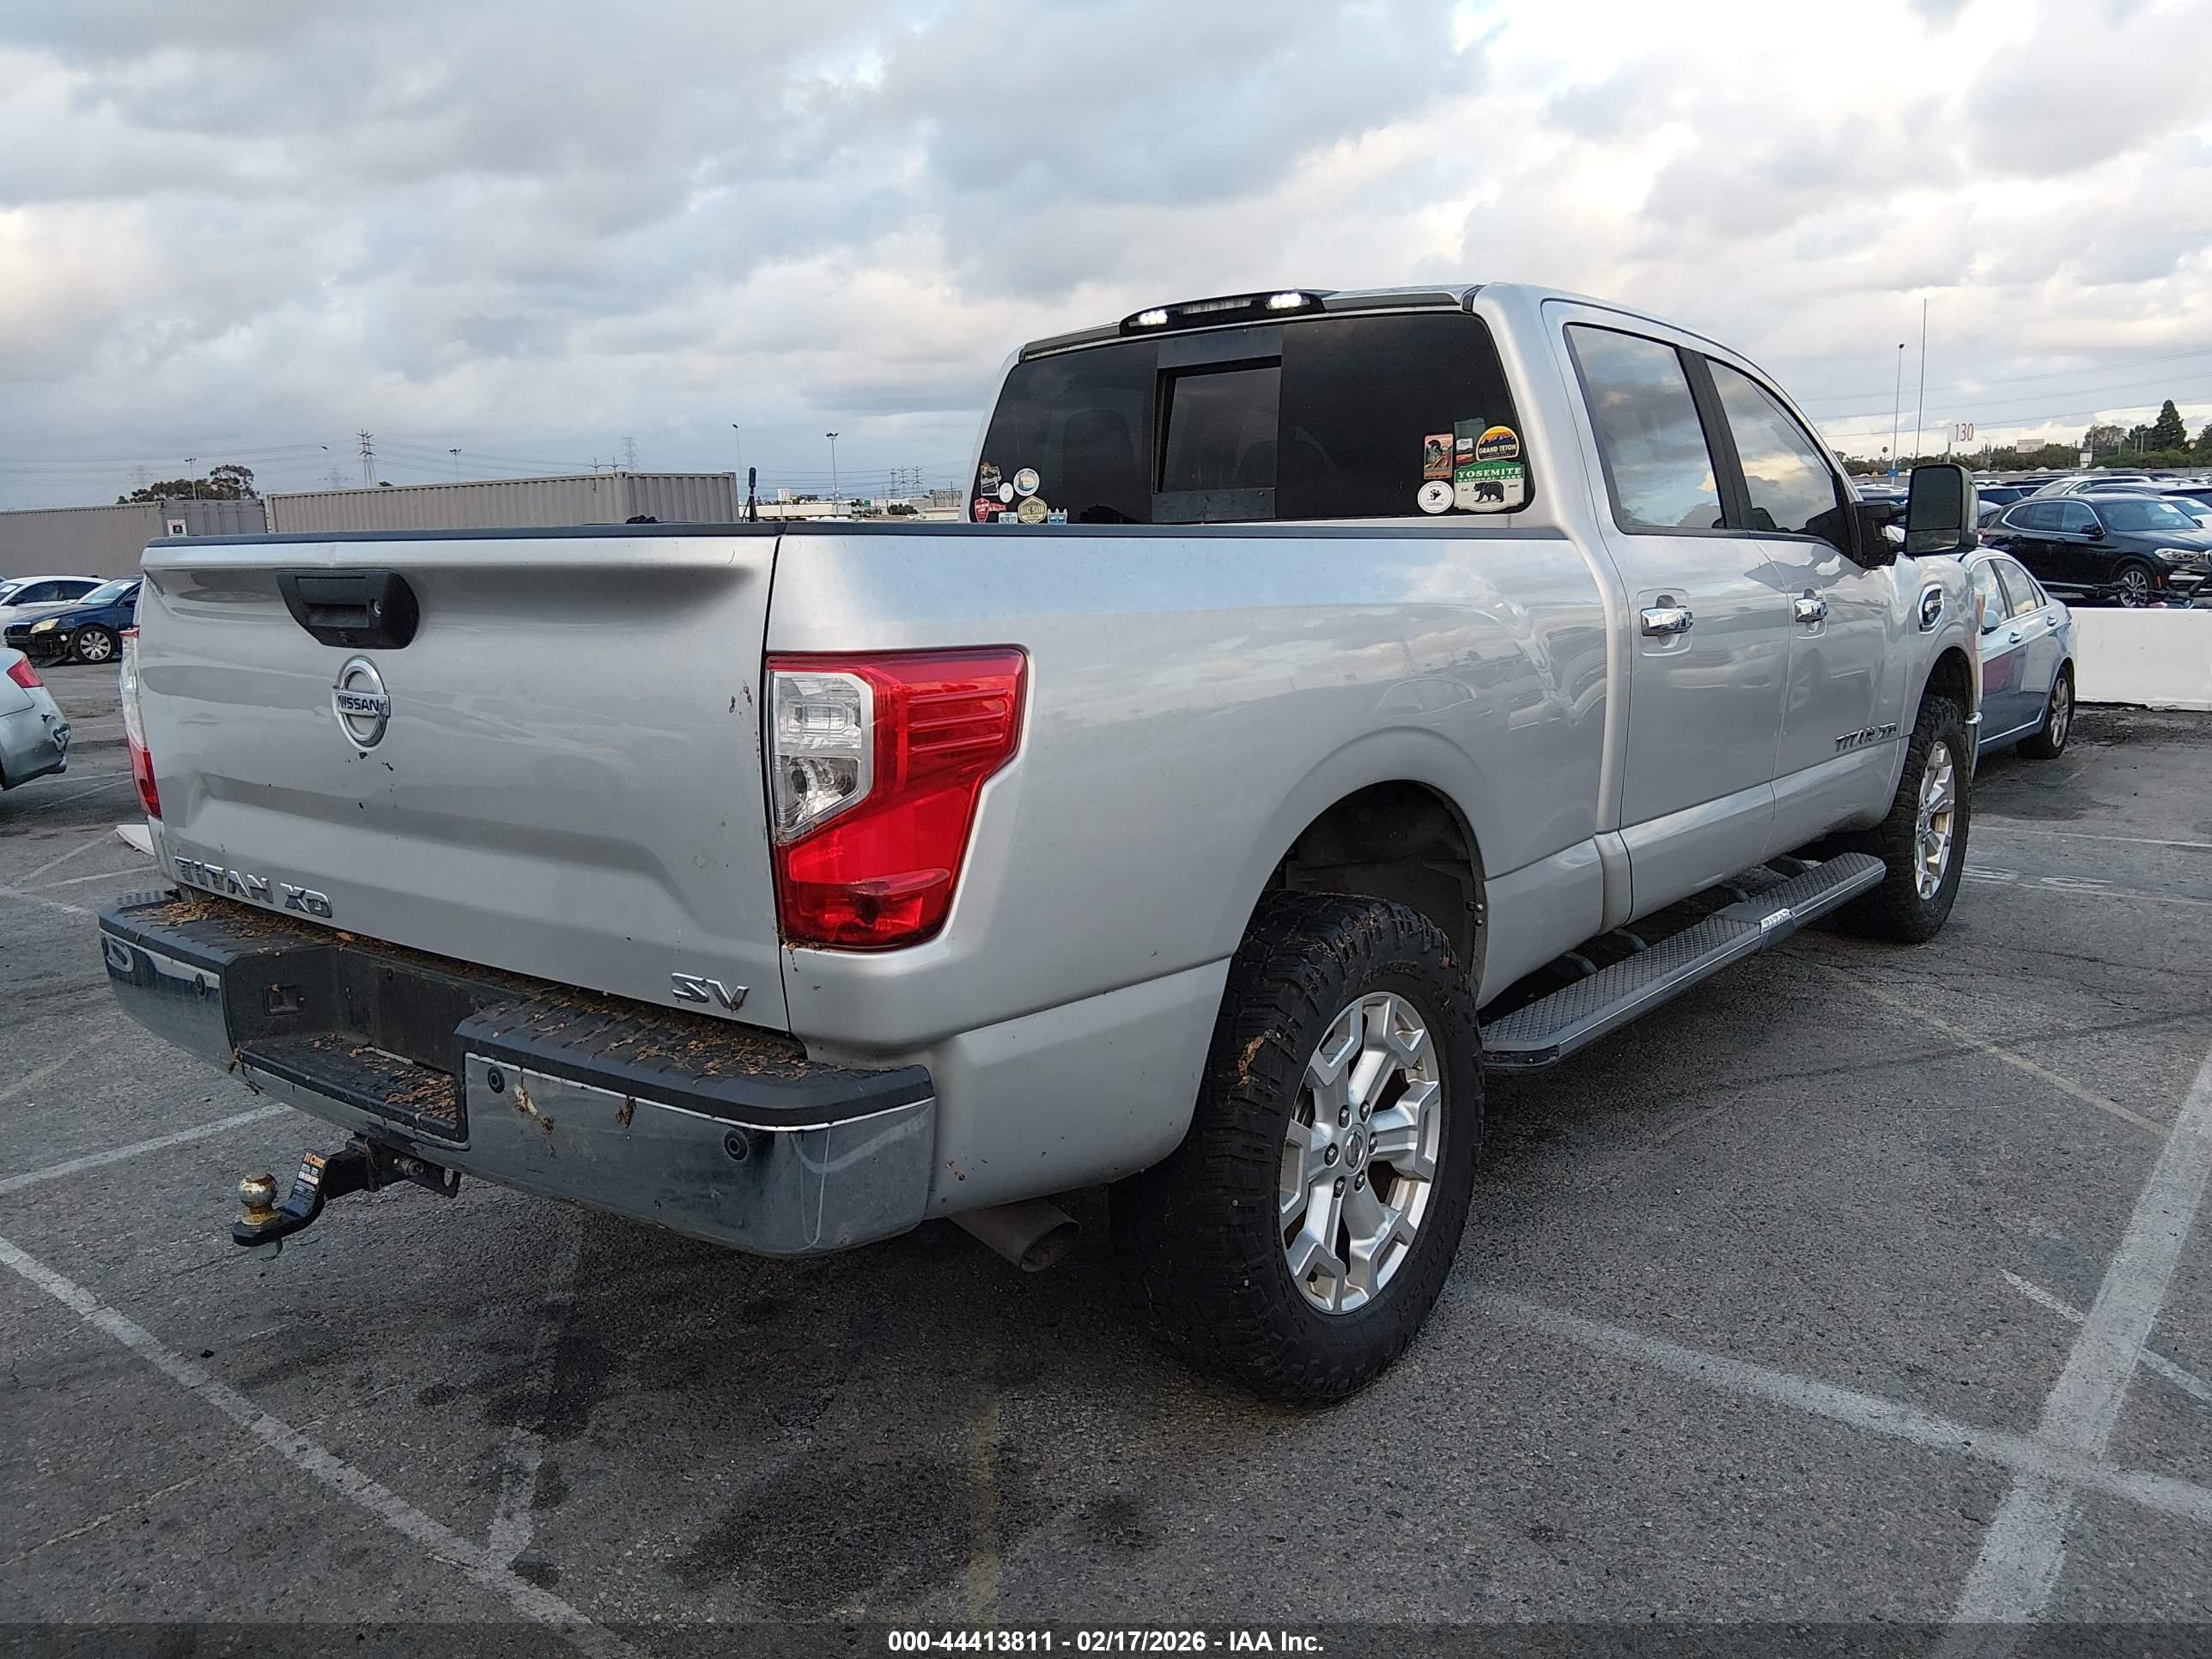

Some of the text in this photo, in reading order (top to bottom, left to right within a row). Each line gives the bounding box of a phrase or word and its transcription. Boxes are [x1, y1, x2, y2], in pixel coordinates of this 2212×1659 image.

[1955, 423, 1973, 441] 130
[1479, 446, 1498, 454] GRAND
[1458, 467, 1522, 478] YOSEMITE
[338, 695, 380, 712] NISSAN
[1835, 727, 1875, 752] TITAN
[174, 856, 333, 918] TITAN XD
[672, 972, 750, 1011] SV
